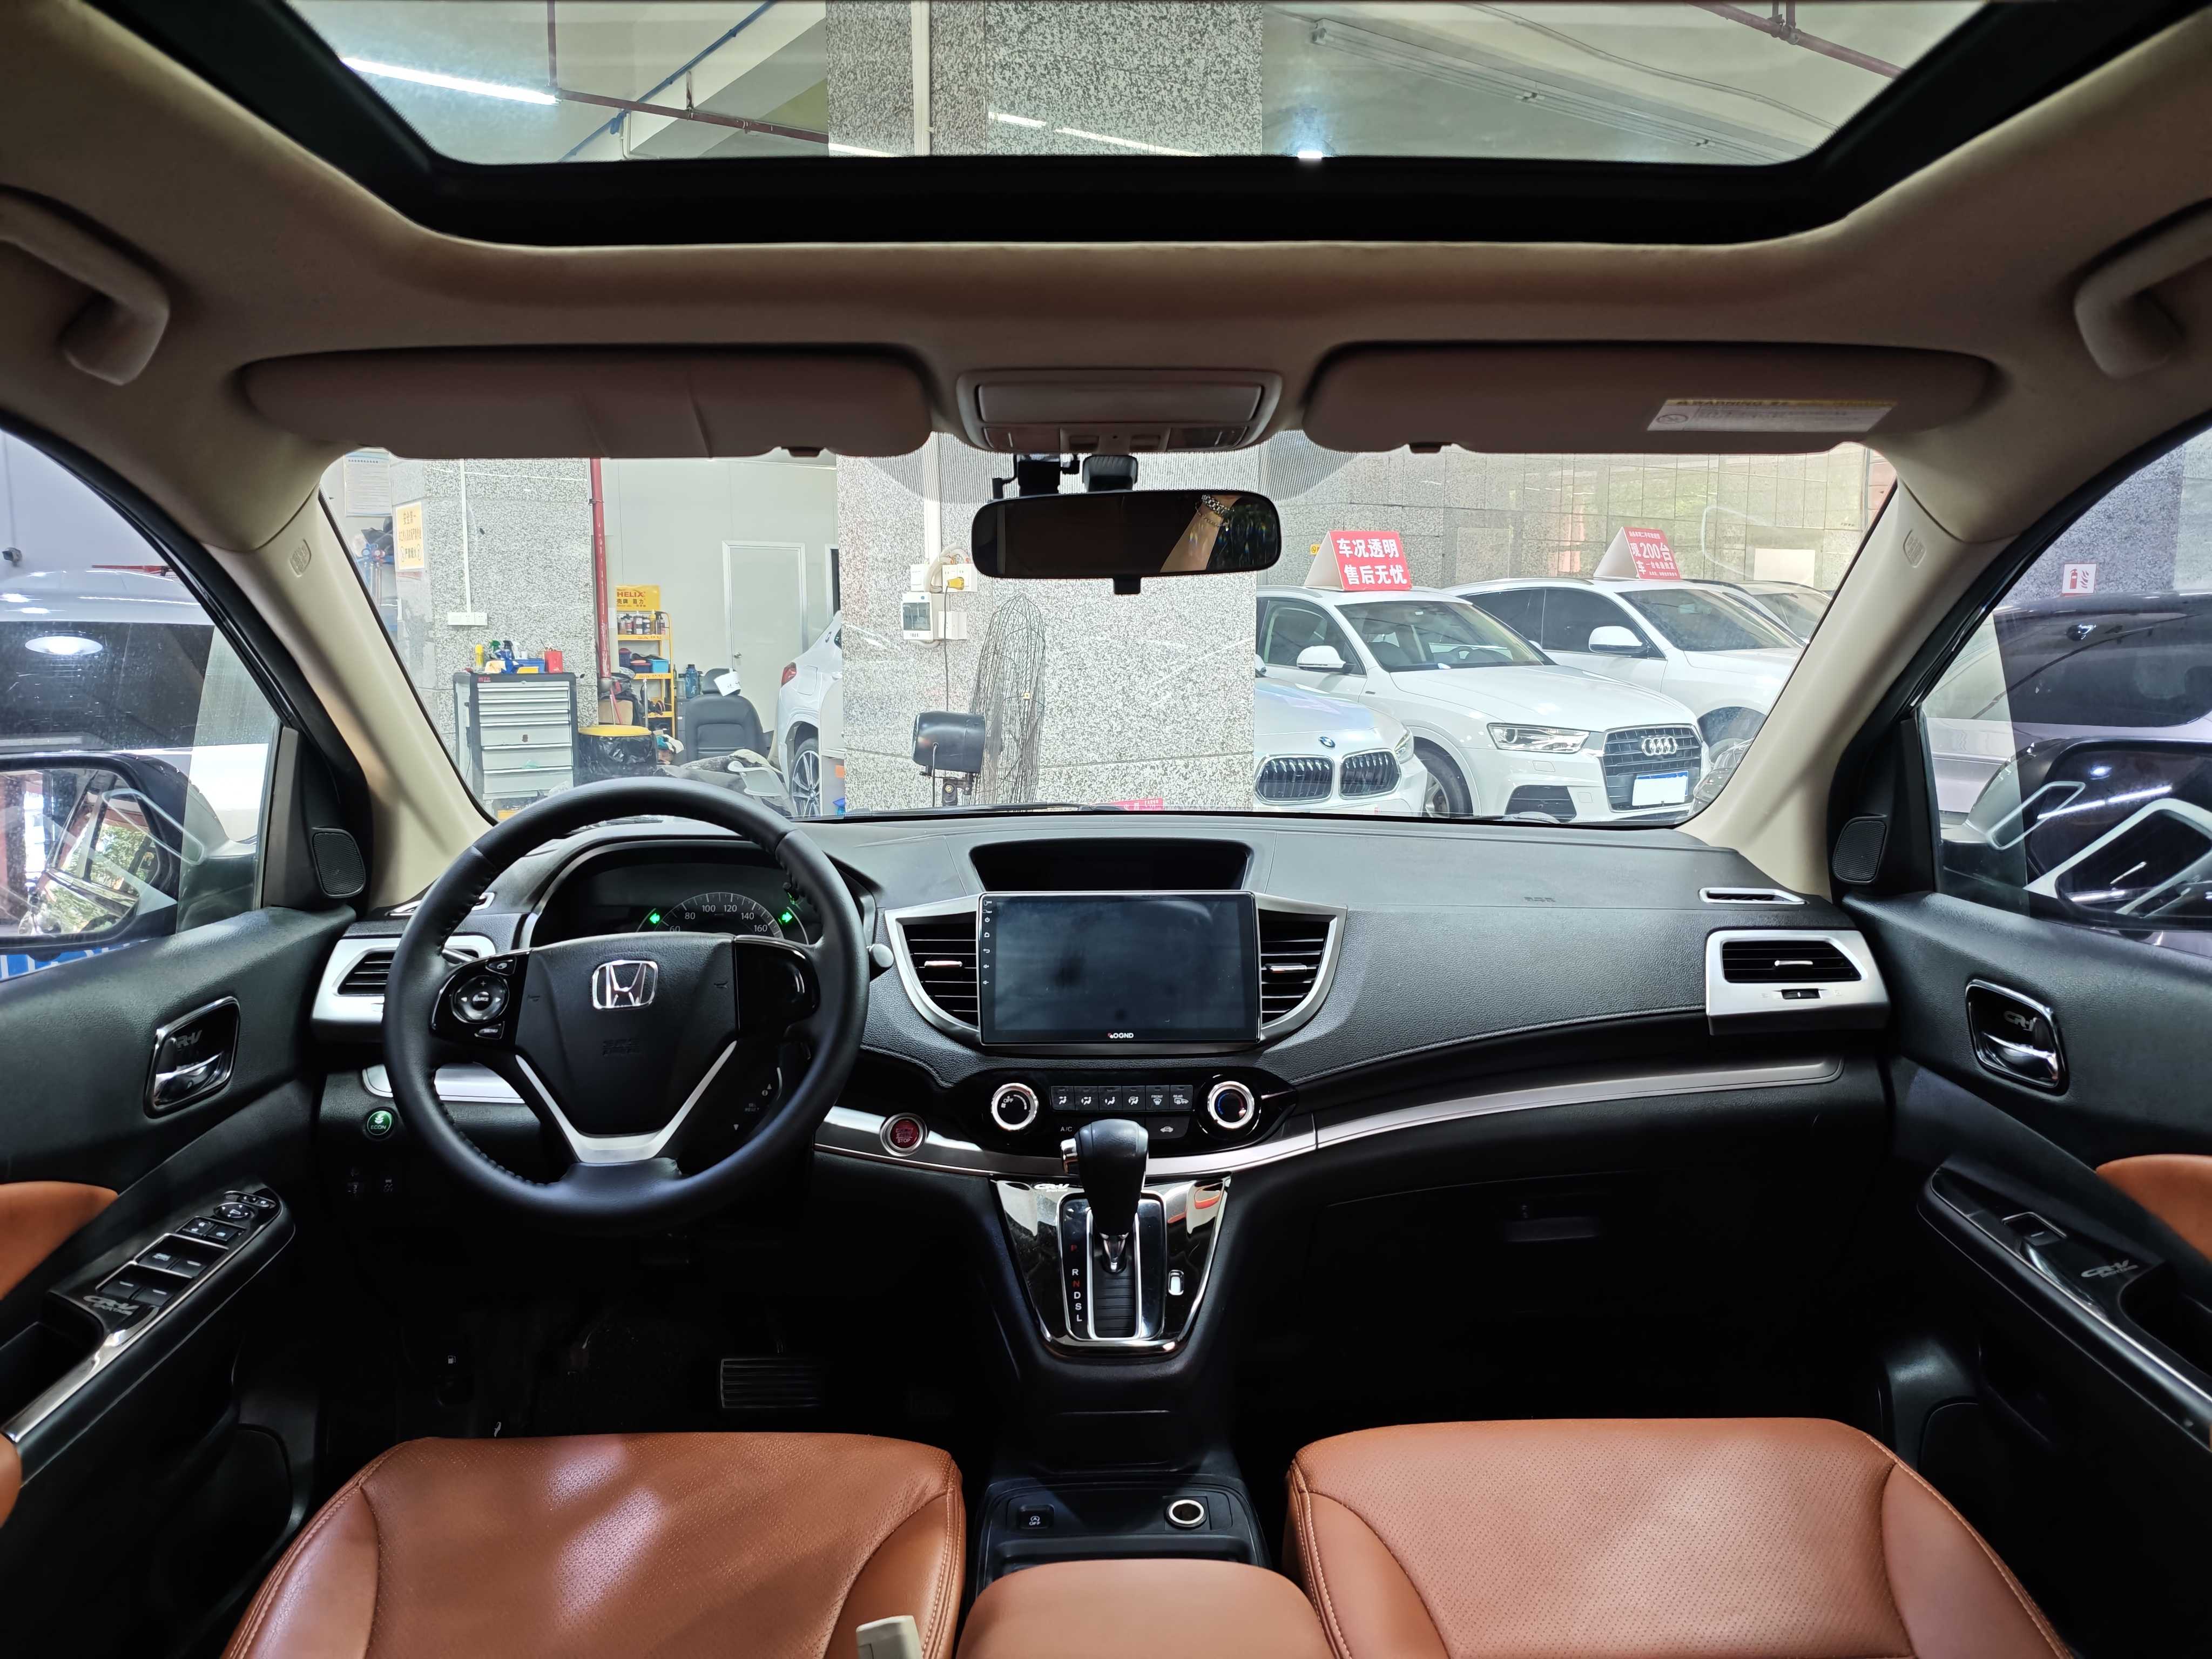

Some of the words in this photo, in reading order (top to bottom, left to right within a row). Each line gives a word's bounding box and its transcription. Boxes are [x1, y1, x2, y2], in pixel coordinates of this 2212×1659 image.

[1337, 538, 1399, 558] 车况透明
[1344, 564, 1407, 584] 售后无忧
[1074, 1291, 1081, 1299] D
[1075, 1303, 1082, 1311] S
